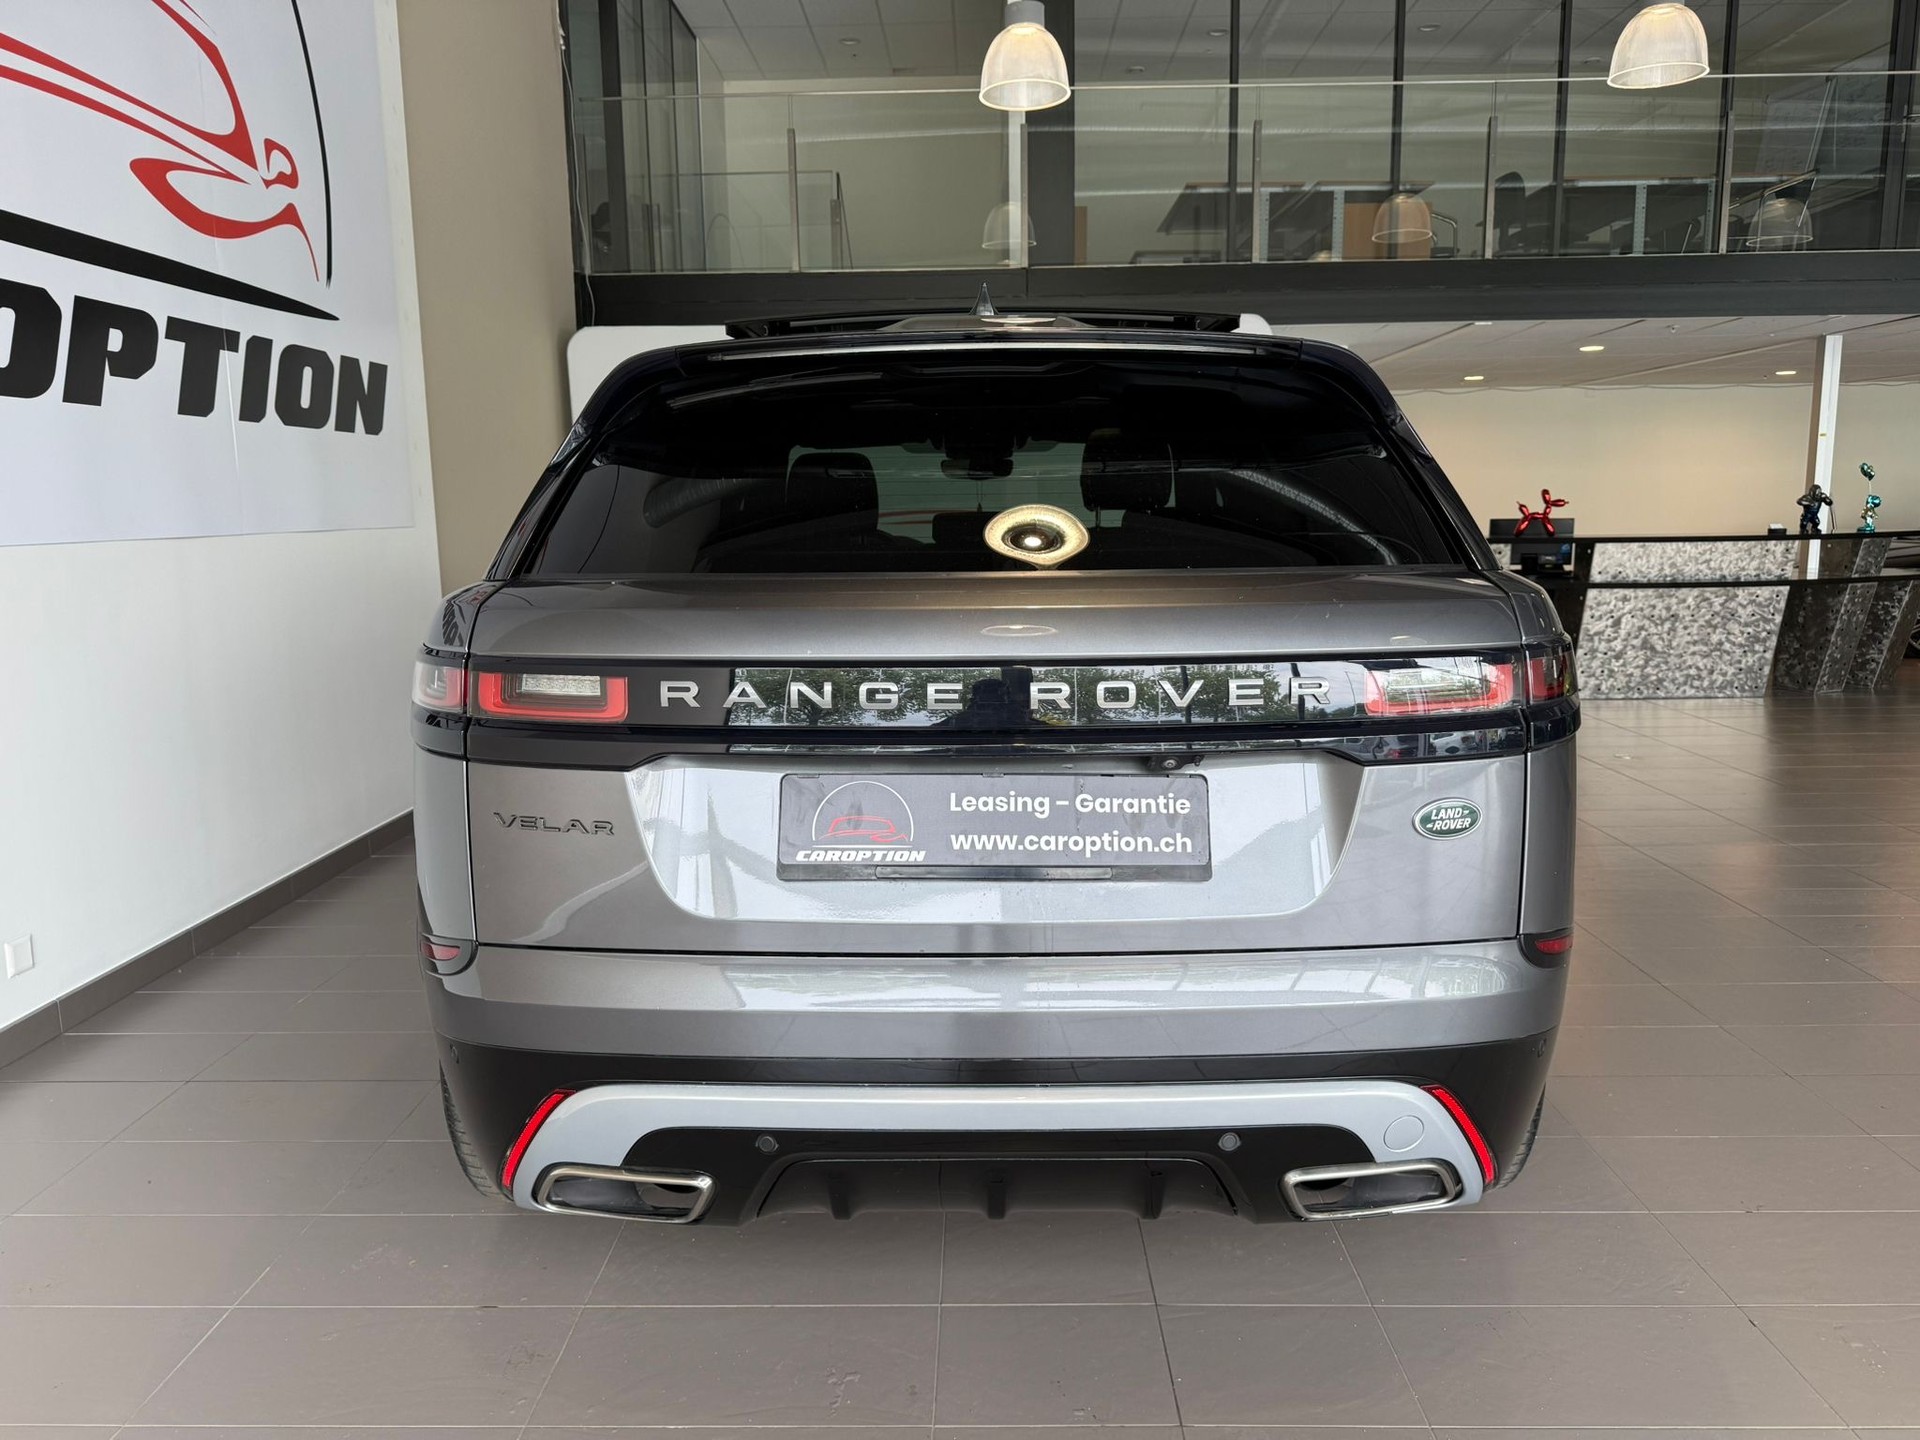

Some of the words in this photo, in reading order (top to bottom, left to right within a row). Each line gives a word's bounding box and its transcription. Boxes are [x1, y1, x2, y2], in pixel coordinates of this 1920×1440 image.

[659, 680, 964, 710] RANGE
[1029, 677, 1331, 710] ROVER
[949, 792, 1051, 818] Leasing
[1074, 794, 1192, 815] Garantie
[493, 811, 615, 836] VELAR
[1433, 817, 1471, 831] ROVER
[795, 850, 926, 863] CAROPTION
[950, 832, 1193, 859] www.caroption.ch
